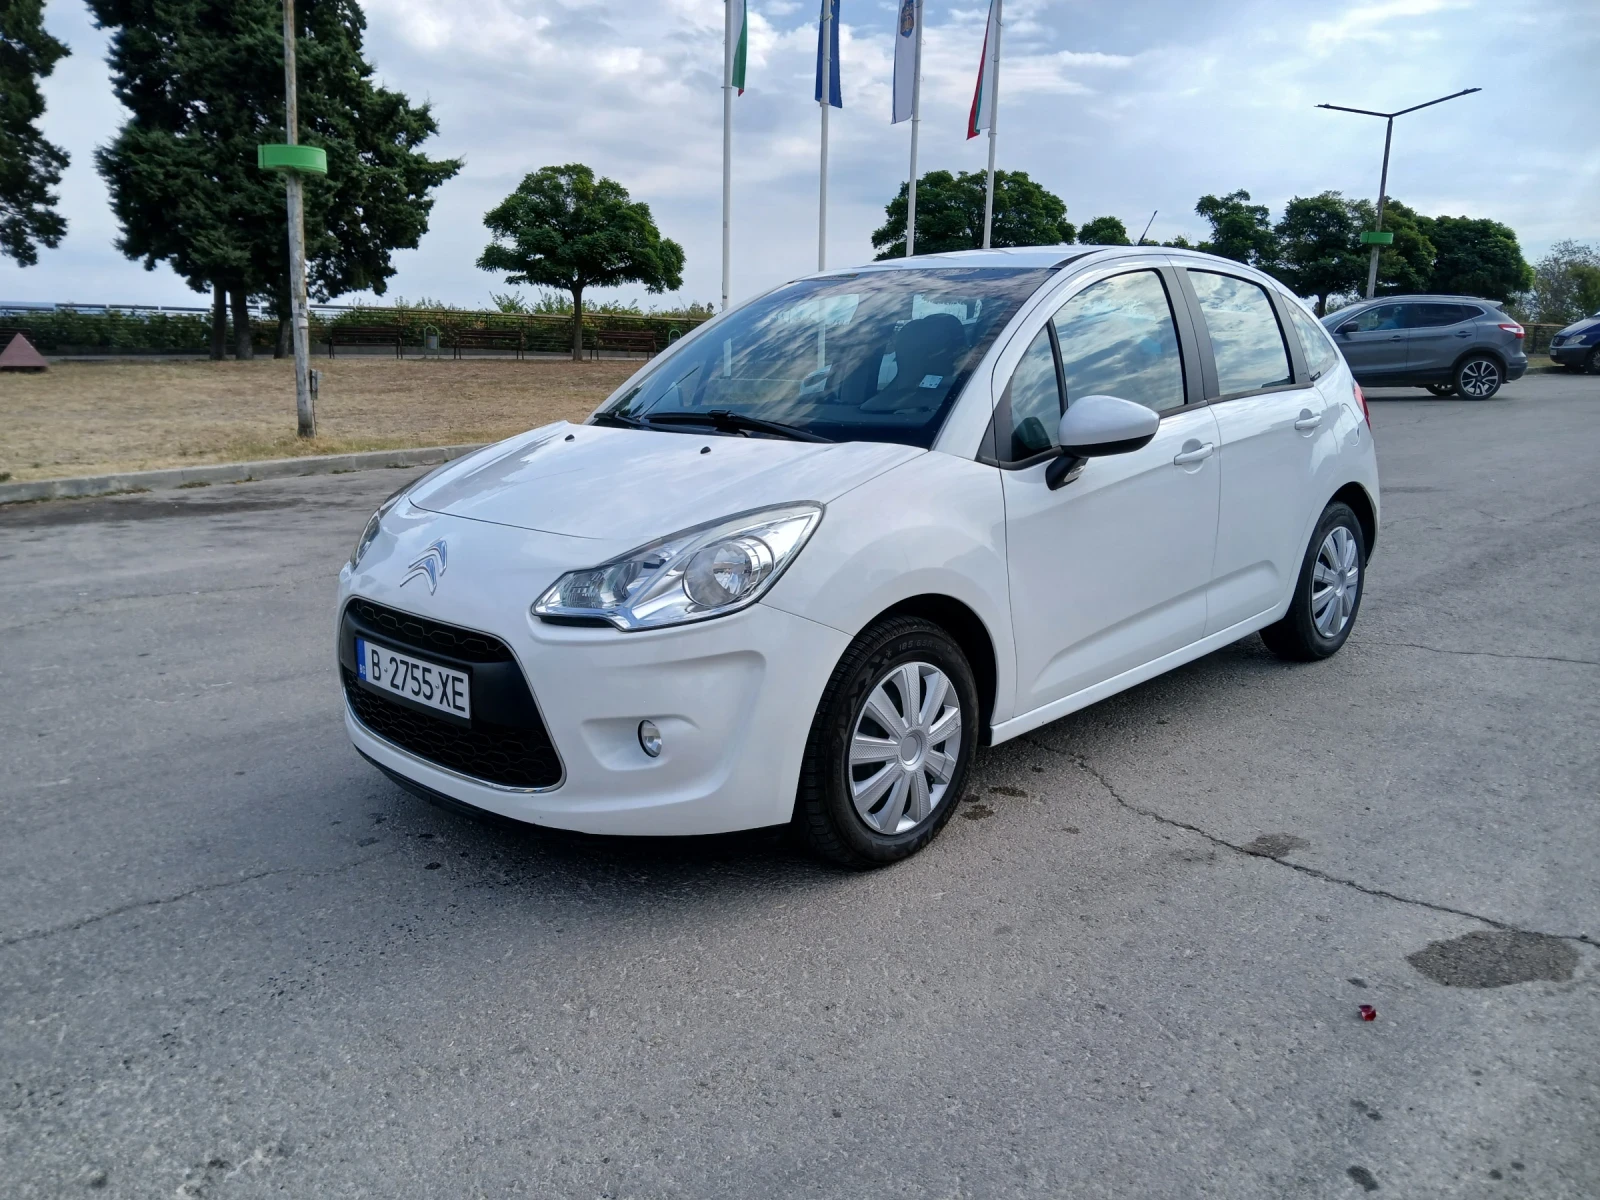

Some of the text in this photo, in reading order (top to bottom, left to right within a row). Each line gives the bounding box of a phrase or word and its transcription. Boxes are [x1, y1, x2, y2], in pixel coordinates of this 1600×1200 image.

[371, 649, 466, 712] B 2755 XE
